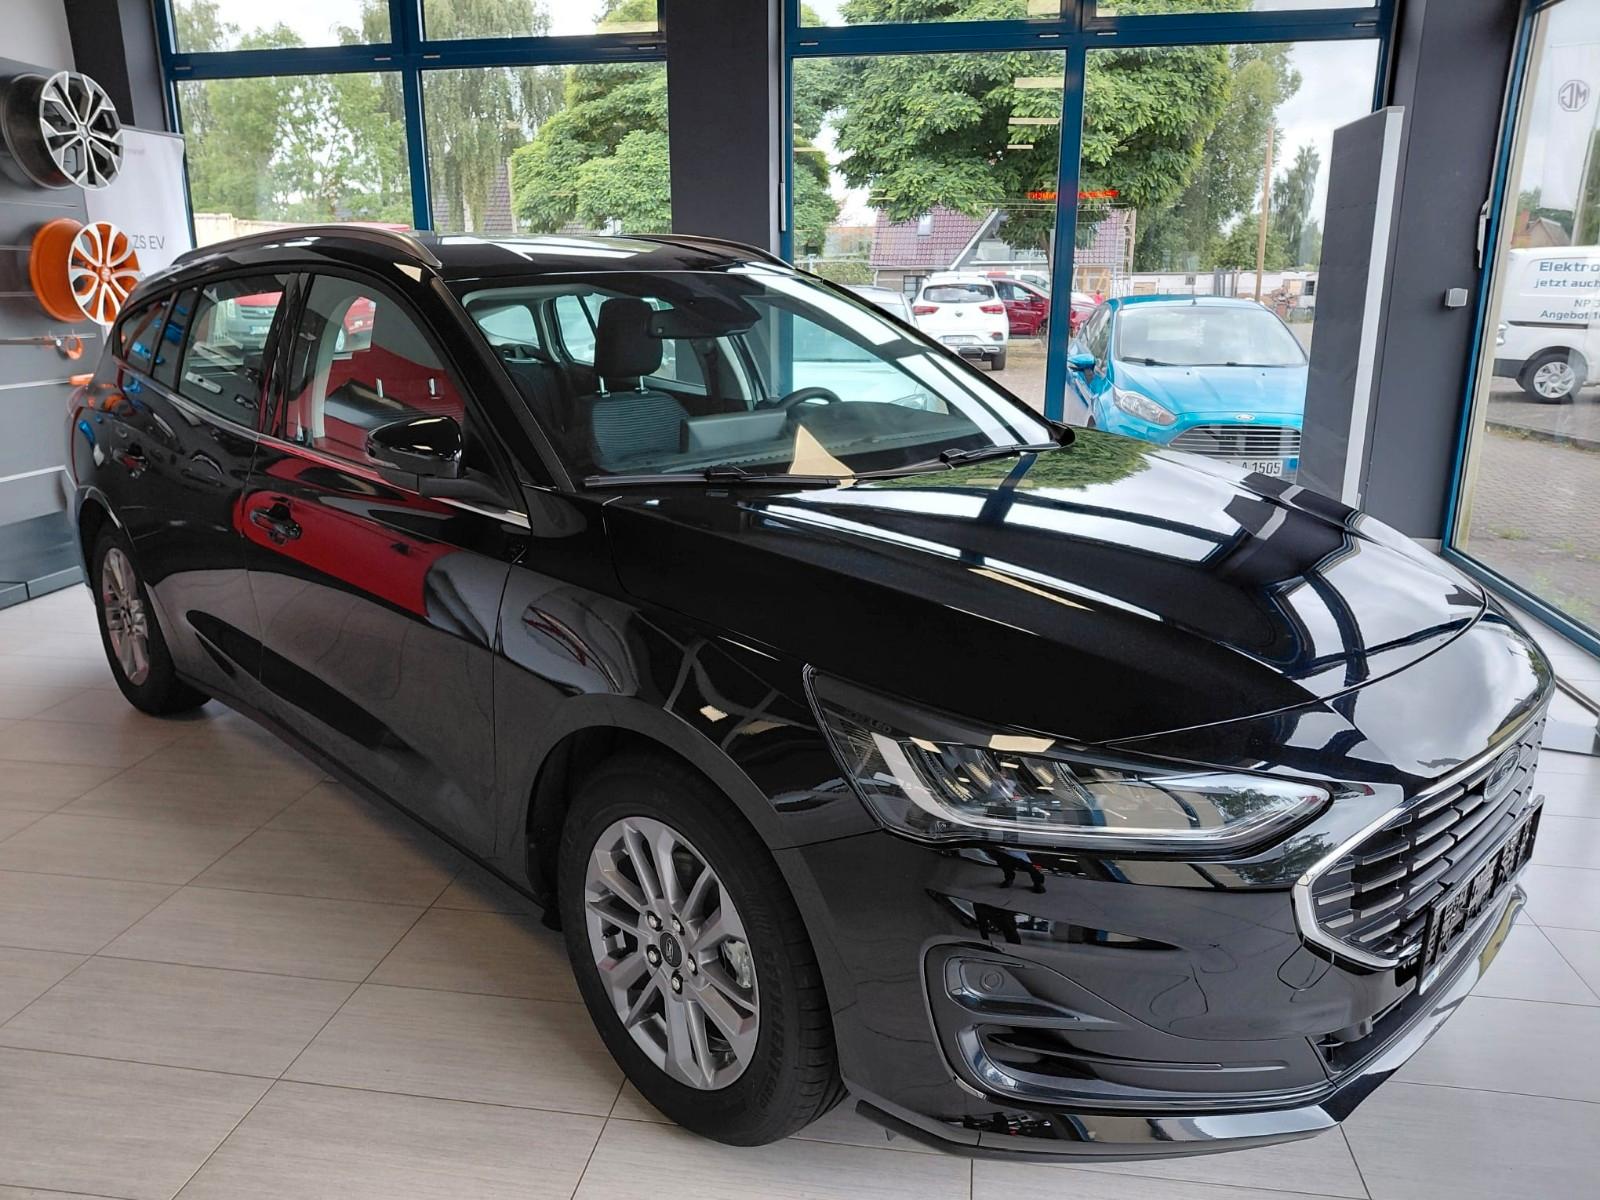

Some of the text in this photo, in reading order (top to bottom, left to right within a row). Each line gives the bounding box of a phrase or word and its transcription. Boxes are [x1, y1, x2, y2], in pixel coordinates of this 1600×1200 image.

[132, 234, 166, 250] ZS EV
[1534, 278, 1567, 289] jetzt
[1540, 309, 1589, 320] Angebot
[1252, 461, 1281, 474] 1505
